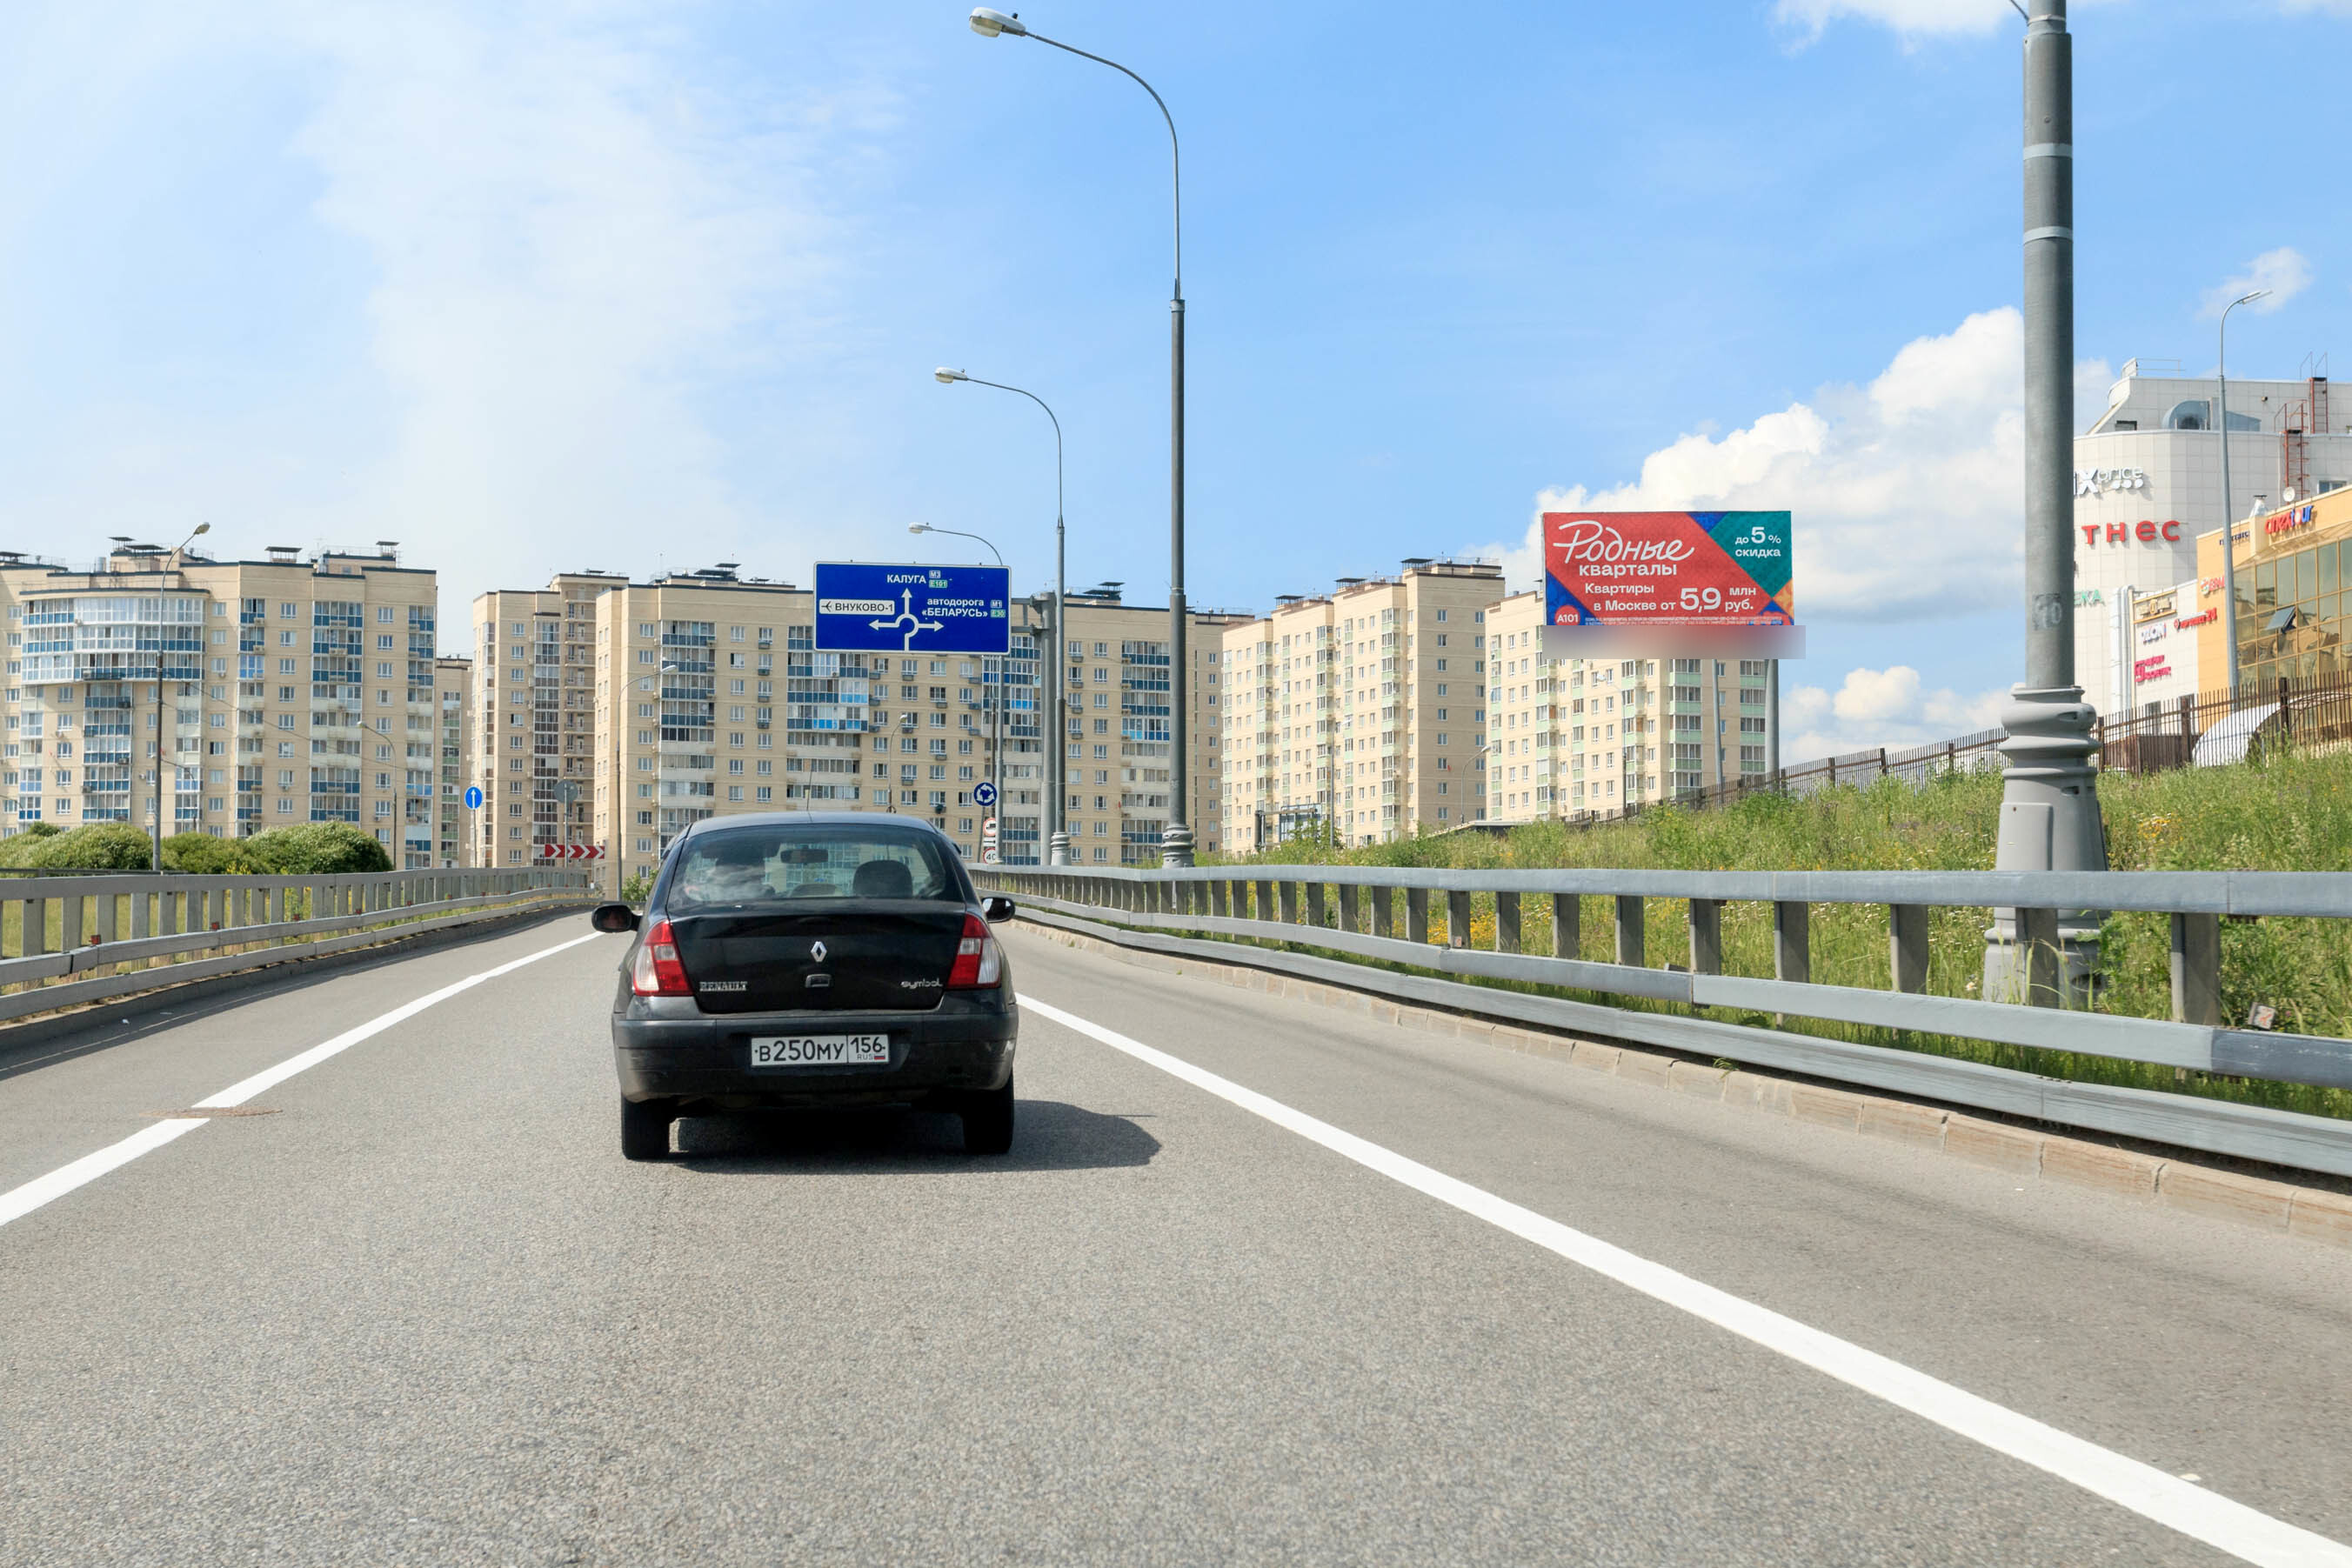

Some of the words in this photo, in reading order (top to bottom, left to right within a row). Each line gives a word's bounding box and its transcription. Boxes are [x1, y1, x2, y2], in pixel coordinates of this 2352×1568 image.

[1734, 536, 1749, 545] до
[1751, 526, 1766, 544] 5
[2081, 519, 2181, 545] тнес
[1553, 520, 1694, 564] Родные
[1734, 549, 1781, 557] скидка
[1579, 564, 1678, 579] кварталы
[886, 574, 926, 584] КАЛУГА
[1585, 583, 1655, 596] Квартиры
[1729, 587, 1756, 596] млн
[926, 598, 985, 608] автодорога
[1594, 602, 1600, 611] в
[1605, 600, 1657, 611] Москве
[1660, 602, 1676, 611] от
[1680, 587, 1721, 612] 5,9
[1725, 598, 1754, 612] руб.
[835, 603, 893, 612] ВНУКОВО-1
[921, 608, 988, 617] «БЕЛАРУСЬ»
[1556, 614, 1579, 623] А101
[699, 981, 748, 991] RENAULT
[900, 976, 944, 990] symbol
[758, 1041, 844, 1061] В250МУ
[850, 1036, 883, 1053] 156
